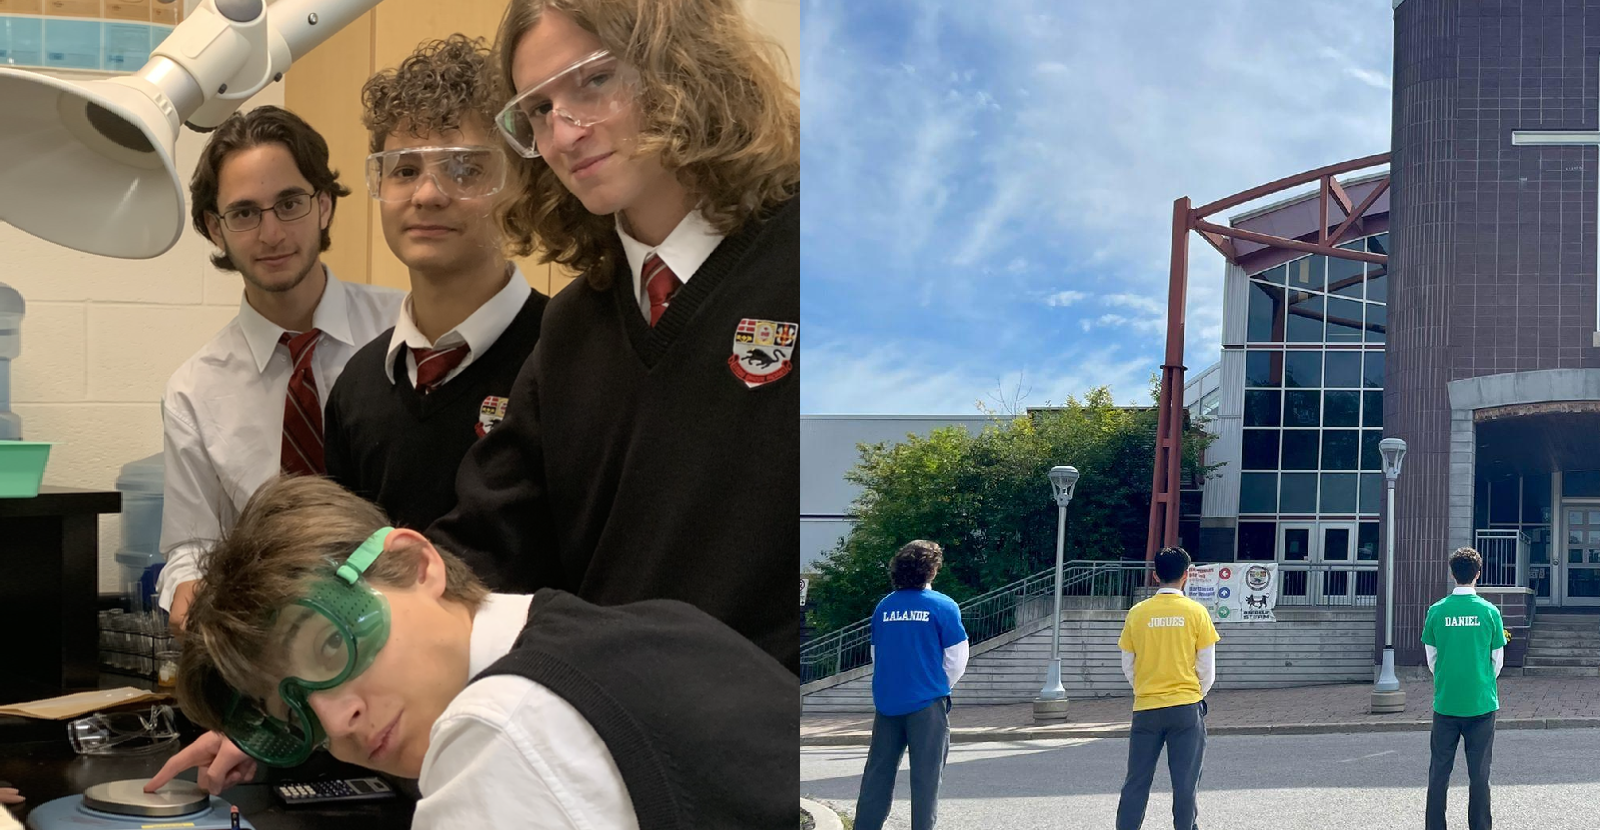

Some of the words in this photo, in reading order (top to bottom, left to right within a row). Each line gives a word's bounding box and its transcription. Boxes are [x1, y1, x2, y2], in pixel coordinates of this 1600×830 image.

[883, 611, 930, 622] LALANDE
[1148, 616, 1184, 627] JOGUES
[1445, 616, 1480, 626] DANIEL
